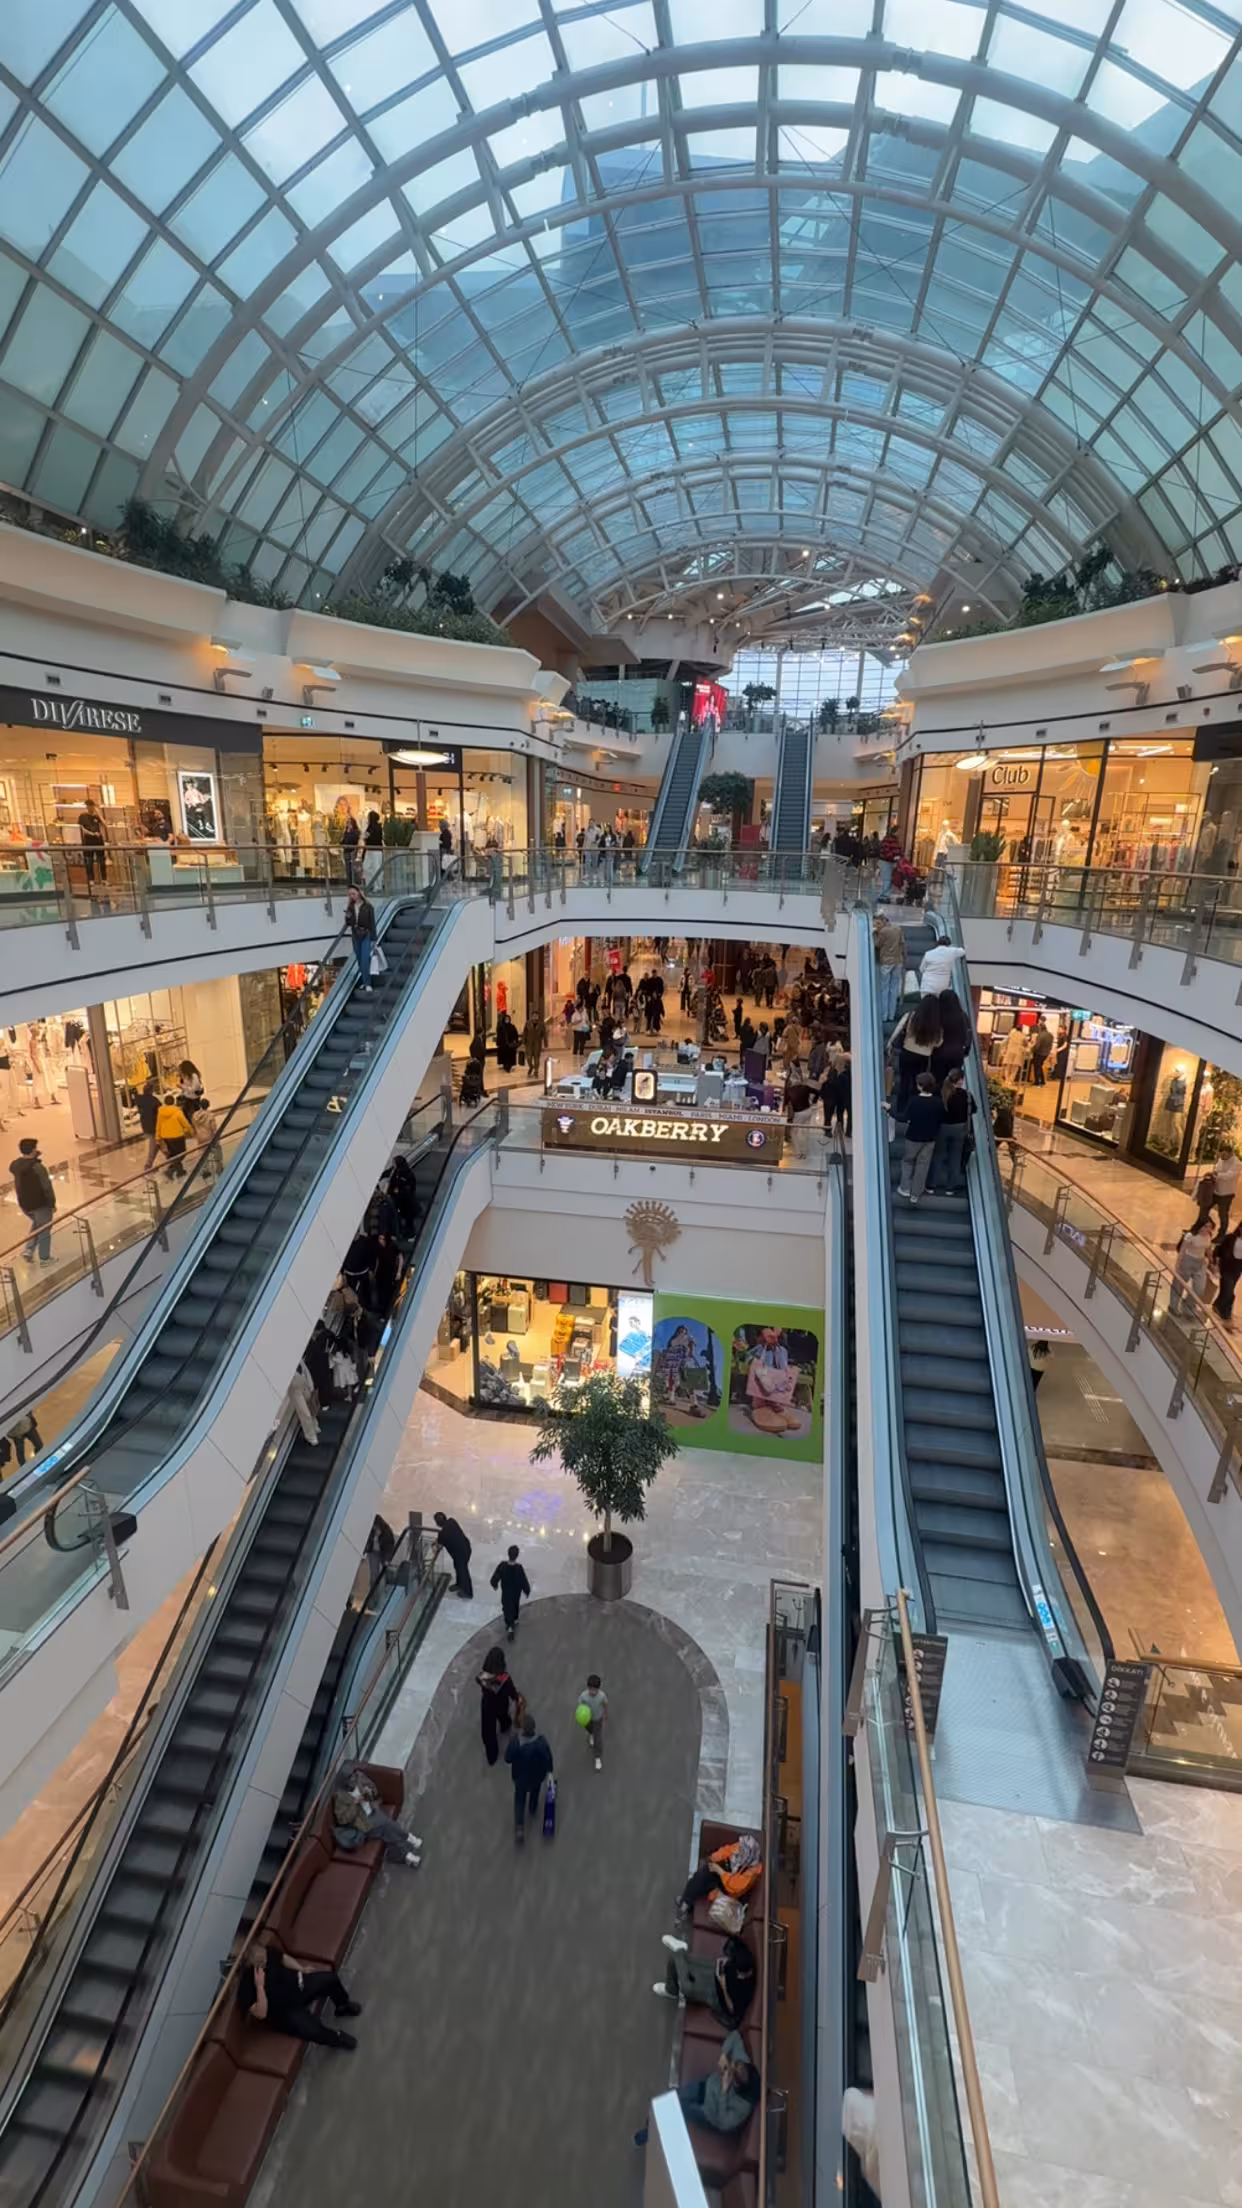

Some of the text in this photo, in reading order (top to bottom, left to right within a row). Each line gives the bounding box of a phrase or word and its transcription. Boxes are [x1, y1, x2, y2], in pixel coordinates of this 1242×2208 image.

[30, 698, 142, 733] DIVARESE
[992, 765, 1029, 785] Club
[591, 1117, 729, 1142] OAKBERRY
